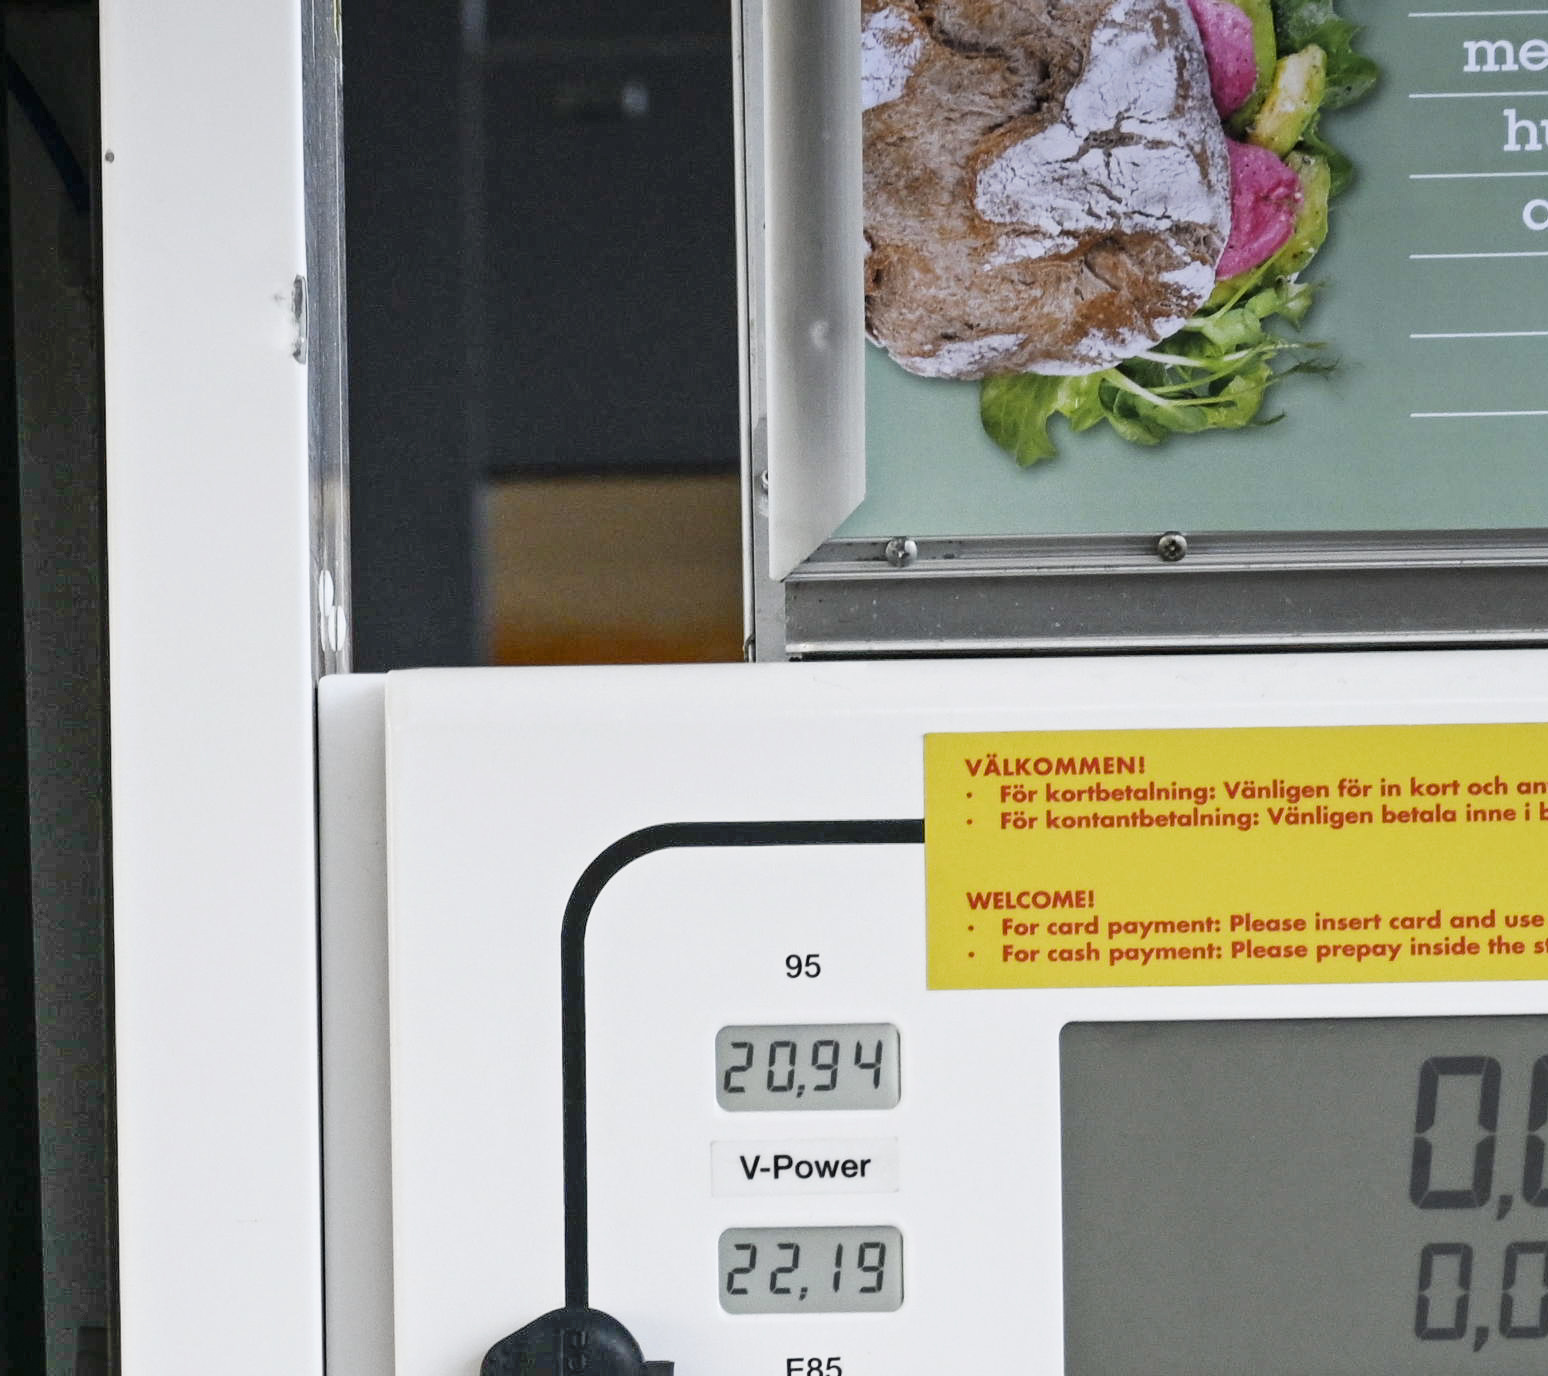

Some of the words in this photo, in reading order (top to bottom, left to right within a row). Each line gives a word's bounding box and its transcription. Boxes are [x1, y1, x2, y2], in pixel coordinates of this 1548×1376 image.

[965, 754, 1144, 776] VÄLKOMMEN!
[1000, 784, 1038, 803] För
[1046, 781, 1215, 805] kortbetalning:
[1224, 779, 1329, 804] Vänligen
[1338, 778, 1372, 797] för
[1381, 778, 1401, 797] in
[1410, 777, 1460, 796] kort
[1467, 776, 1508, 795] och
[1001, 811, 1038, 829] För
[1046, 807, 1259, 830] kontantbetalning:
[1267, 806, 1373, 828] Vänligen
[1382, 803, 1456, 823] betala
[1466, 803, 1516, 822] inne
[1525, 802, 1530, 821] i
[966, 890, 1094, 910] WELCOME!
[1002, 918, 1039, 936] For
[1047, 915, 1099, 935] card
[1108, 917, 1220, 939] payment:
[1230, 912, 1306, 932] Please
[1315, 912, 1382, 931] insert
[1389, 910, 1441, 930] card
[1450, 909, 1496, 928] and
[1505, 915, 1544, 928] use
[1003, 944, 1040, 962] For
[1048, 942, 1100, 962] cash
[1110, 944, 1222, 965] payment:
[1232, 939, 1308, 958] Please
[1316, 944, 1402, 962] prepay
[1411, 936, 1480, 956] inside
[1488, 935, 1525, 954] the
[786, 954, 821, 978] 95
[723, 1040, 882, 1098] 20,94
[740, 1155, 871, 1180] V-Power
[727, 1242, 886, 1301] 22,19
